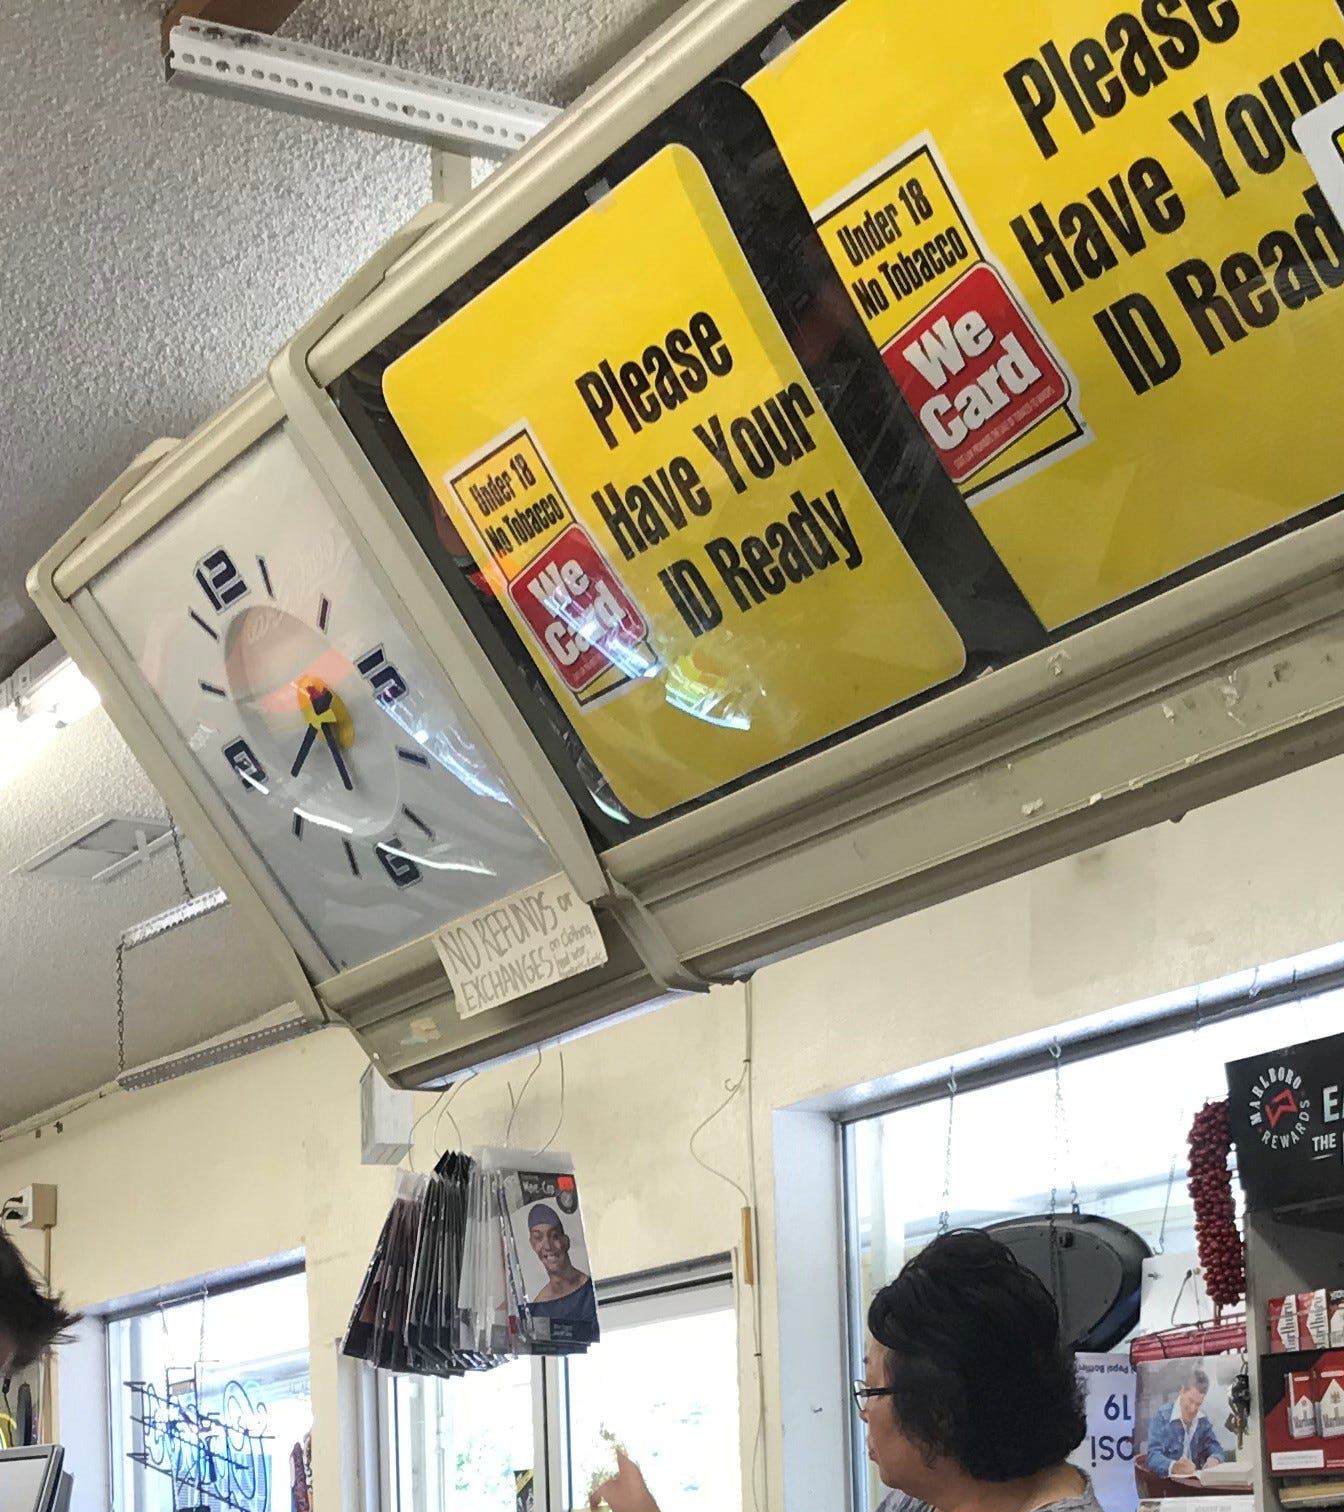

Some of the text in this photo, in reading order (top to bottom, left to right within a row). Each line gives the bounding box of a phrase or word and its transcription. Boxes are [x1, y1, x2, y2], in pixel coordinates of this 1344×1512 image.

[1003, 0, 1240, 160] Please
[837, 178, 934, 268] Under 18
[1009, 156, 1186, 304] Have
[852, 225, 967, 321] No Tobacco
[575, 312, 733, 450] Please
[903, 308, 995, 389] We
[1093, 292, 1183, 395] ID
[918, 332, 1042, 451] Card
[469, 454, 536, 517] Under 18
[591, 380, 816, 561] Have Your
[486, 493, 565, 557] No Tobacco
[657, 490, 863, 638] ID Ready
[193, 545, 251, 615] 12
[528, 557, 590, 619] We
[439, 927, 482, 975] NO
[472, 891, 558, 961] REFUNDS
[460, 946, 553, 1012] EXCHANGES
[1250, 1066, 1302, 1127] MARLBORO
[1261, 1099, 1310, 1150] REWARDS
[1312, 1133, 1336, 1152] THE
